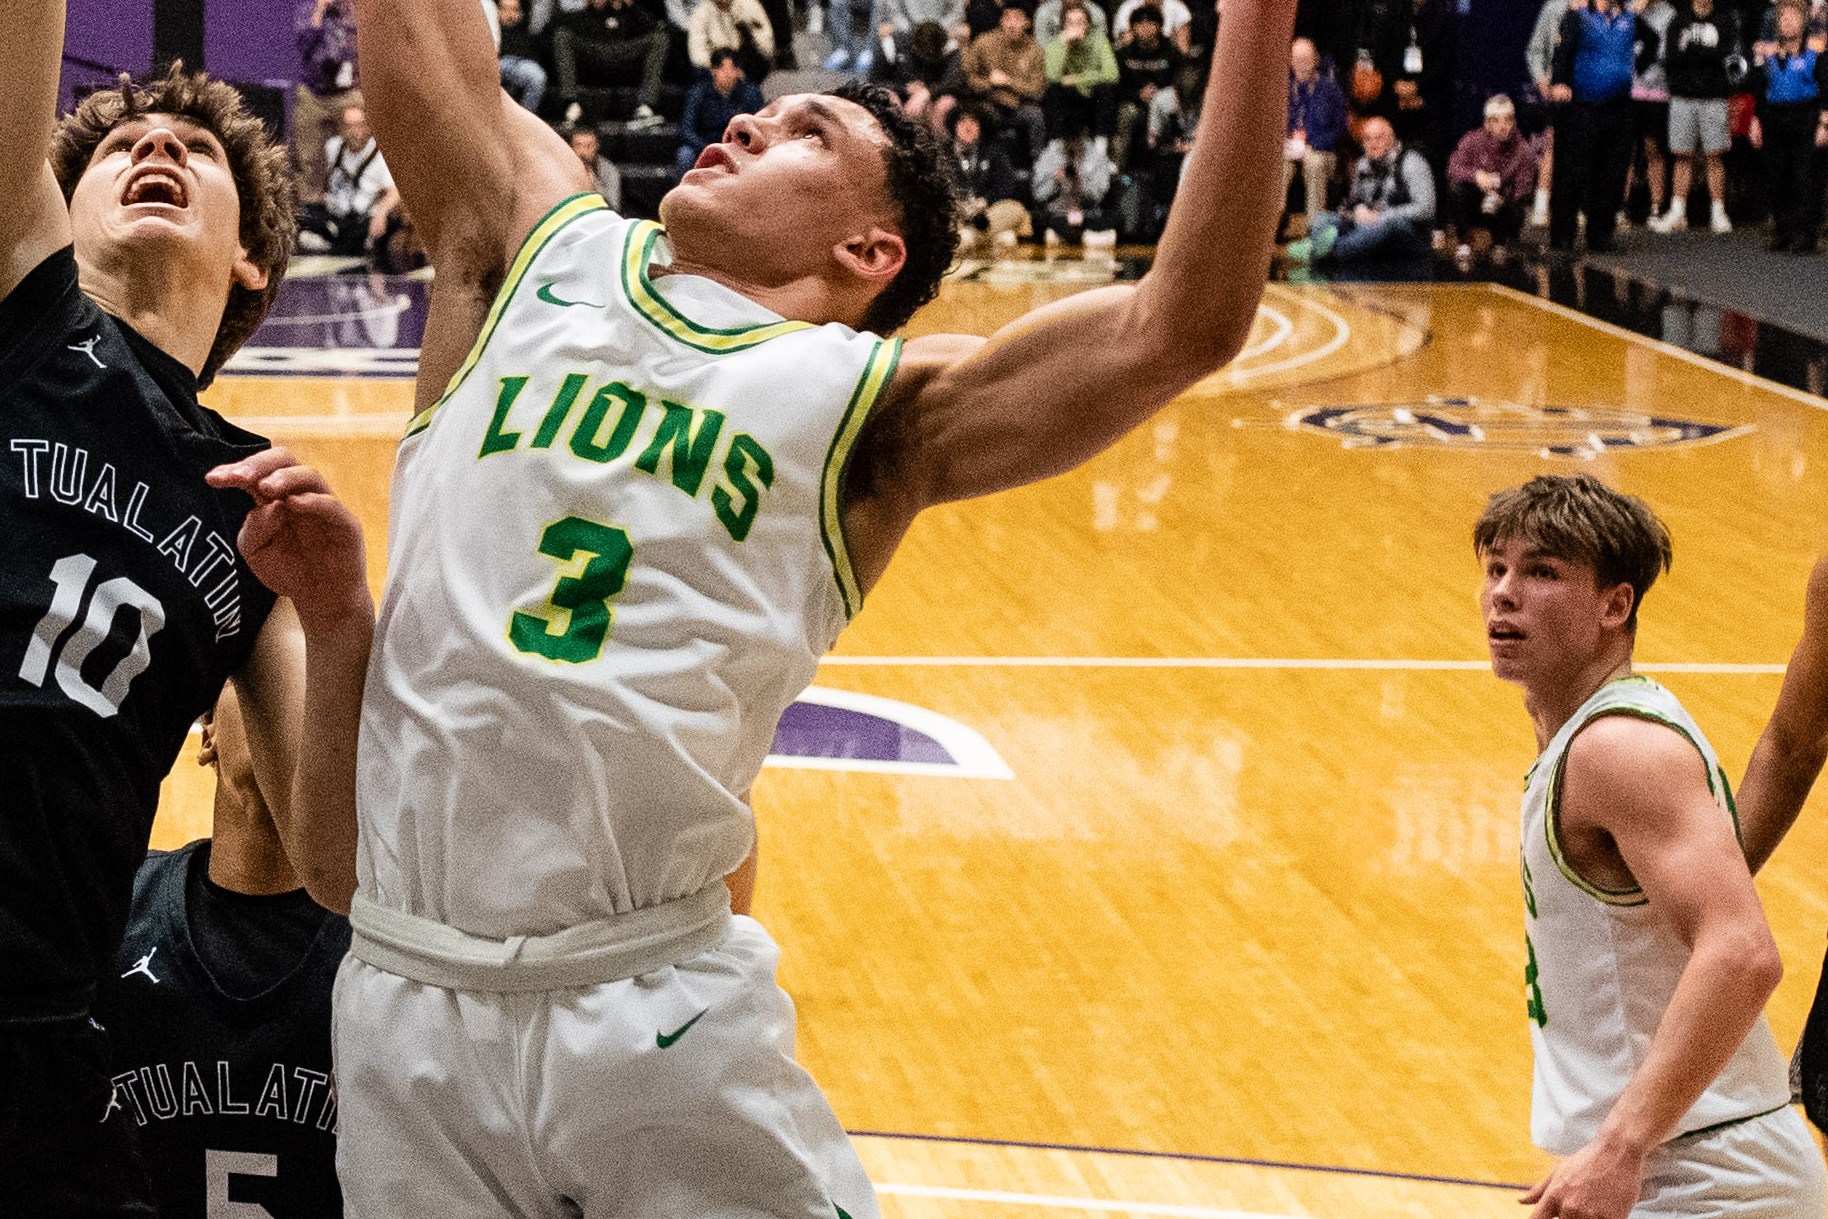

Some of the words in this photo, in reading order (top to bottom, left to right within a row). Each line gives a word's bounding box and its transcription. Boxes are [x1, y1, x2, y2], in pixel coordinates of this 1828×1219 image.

[476, 372, 776, 543] LIONS
[10, 438, 242, 644] TUALATIN
[506, 515, 635, 664] 3
[18, 552, 167, 719] 10
[110, 1061, 338, 1134] TUALATI
[205, 1148, 278, 1219] 5
